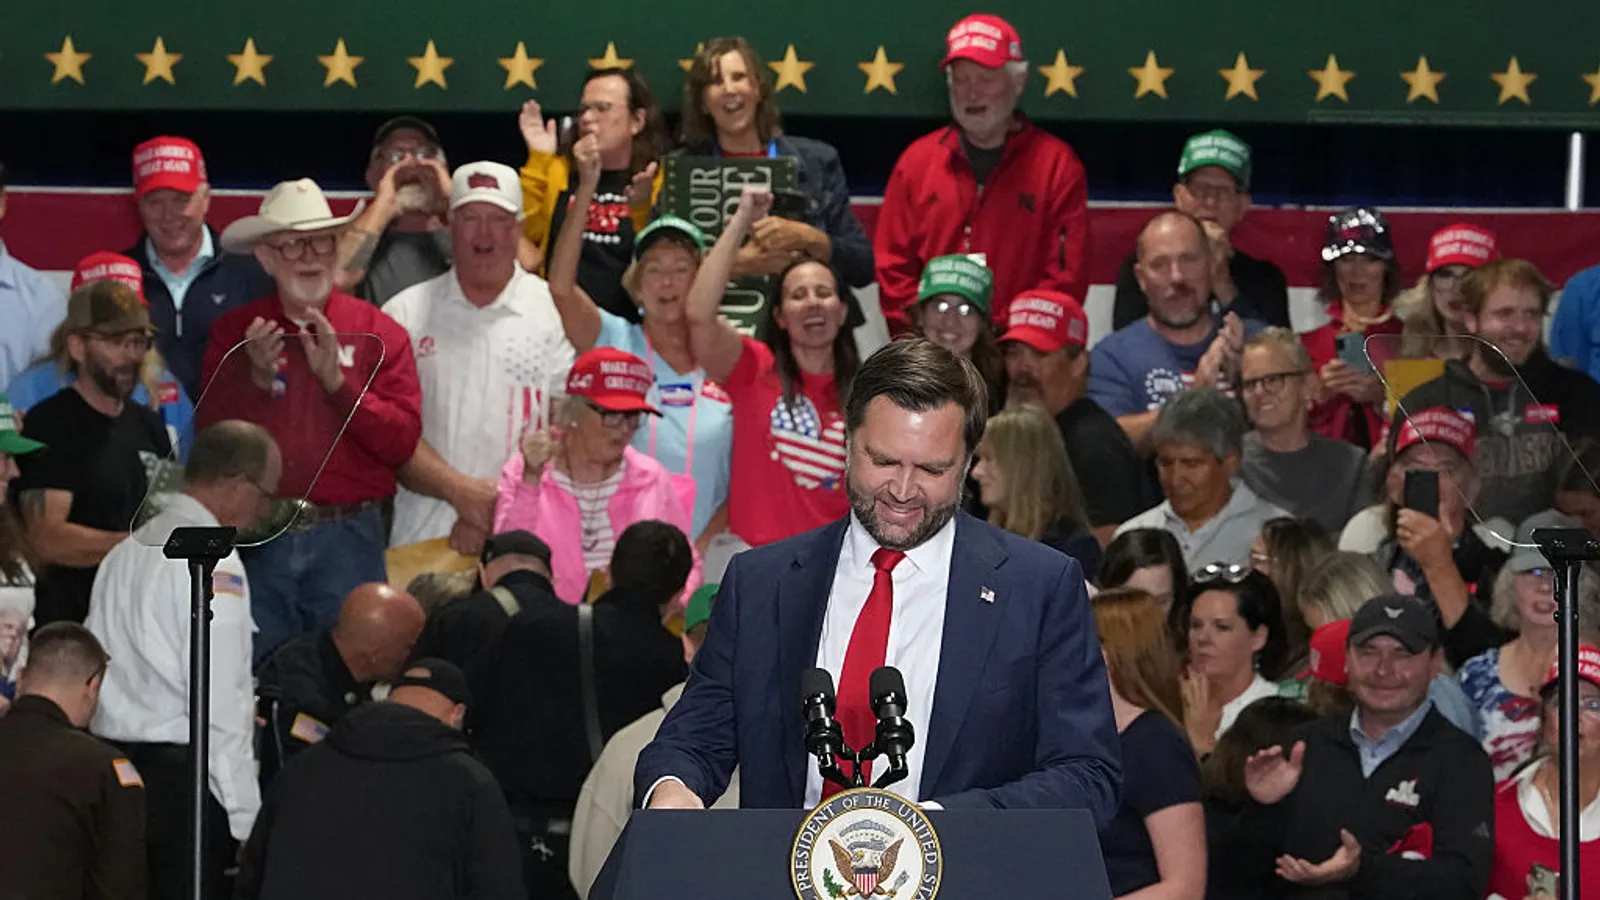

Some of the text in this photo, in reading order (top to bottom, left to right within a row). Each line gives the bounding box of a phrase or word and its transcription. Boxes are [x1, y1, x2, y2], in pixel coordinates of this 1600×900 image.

[795, 803, 836, 891] PRESIDENT
[842, 797, 859, 809] OF
[866, 795, 891, 809] THE
[898, 805, 938, 865] UNITED
